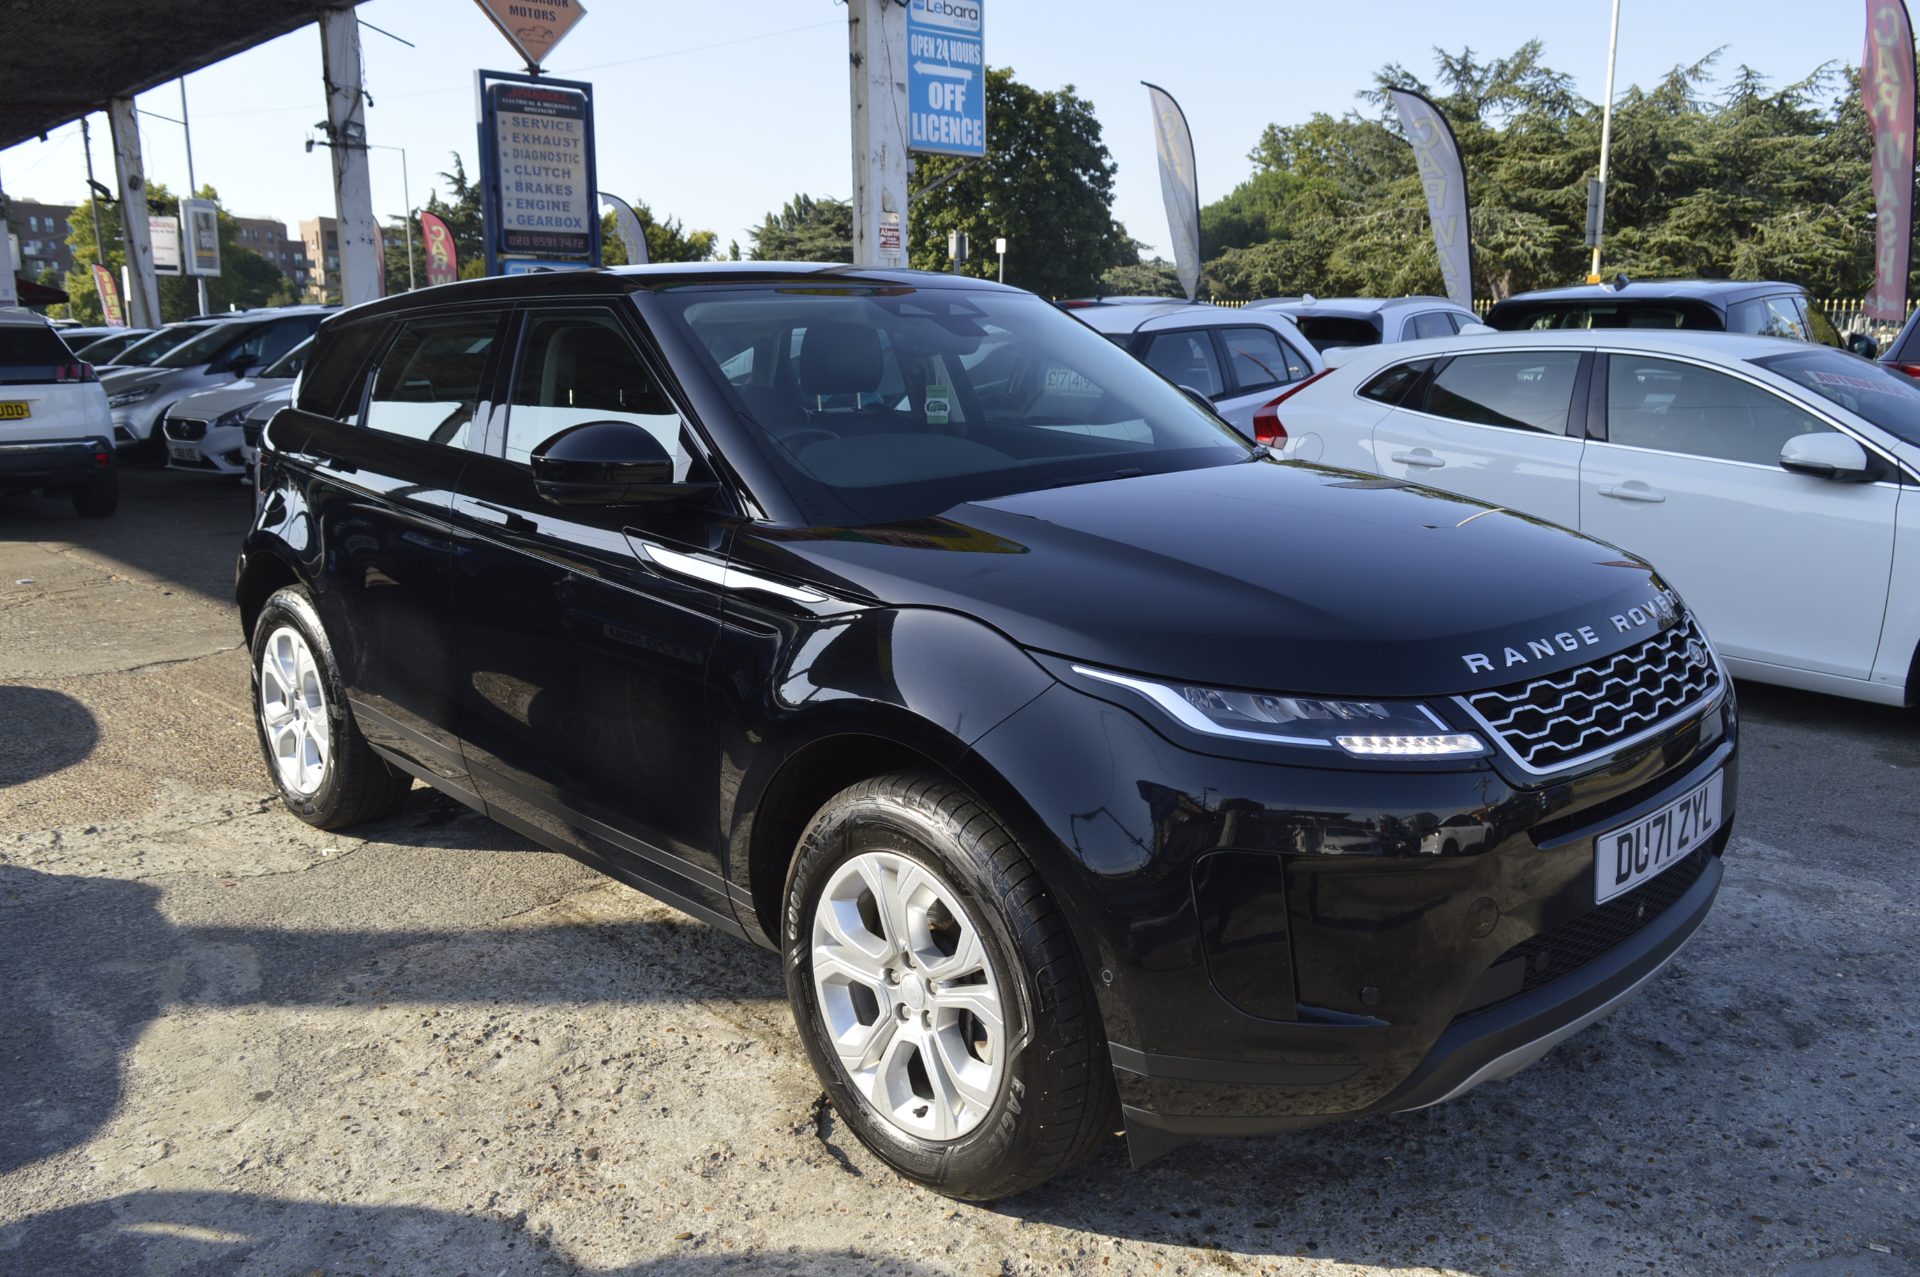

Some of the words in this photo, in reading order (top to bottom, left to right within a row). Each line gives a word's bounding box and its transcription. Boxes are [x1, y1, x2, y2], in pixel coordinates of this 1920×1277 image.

[509, 5, 556, 21] MOTORS
[926, 0, 978, 20] Lebara
[911, 34, 935, 59] OPEN
[936, 38, 949, 60] 24
[950, 42, 980, 65] HOURS
[502, 97, 535, 107] ELECTRICAL
[928, 81, 966, 112] OFF
[512, 117, 574, 132] SERVICE
[912, 112, 982, 146] LICENCE
[512, 133, 580, 148] EXHAUST
[513, 149, 580, 164] DIAGNOSTIC
[514, 165, 571, 179] CLUTCH
[515, 181, 572, 196] BRAKES
[516, 198, 571, 212] ENGINE
[517, 214, 582, 229] GEARBOX
[880, 228, 900, 237] Alarm
[509, 235, 530, 246] 020
[560, 238, 584, 249] 7472
[1461, 625, 1600, 674] RANGE
[1609, 589, 1679, 633] ROVER
[1615, 809, 1673, 886] DU71
[1677, 786, 1712, 851] ZYL
